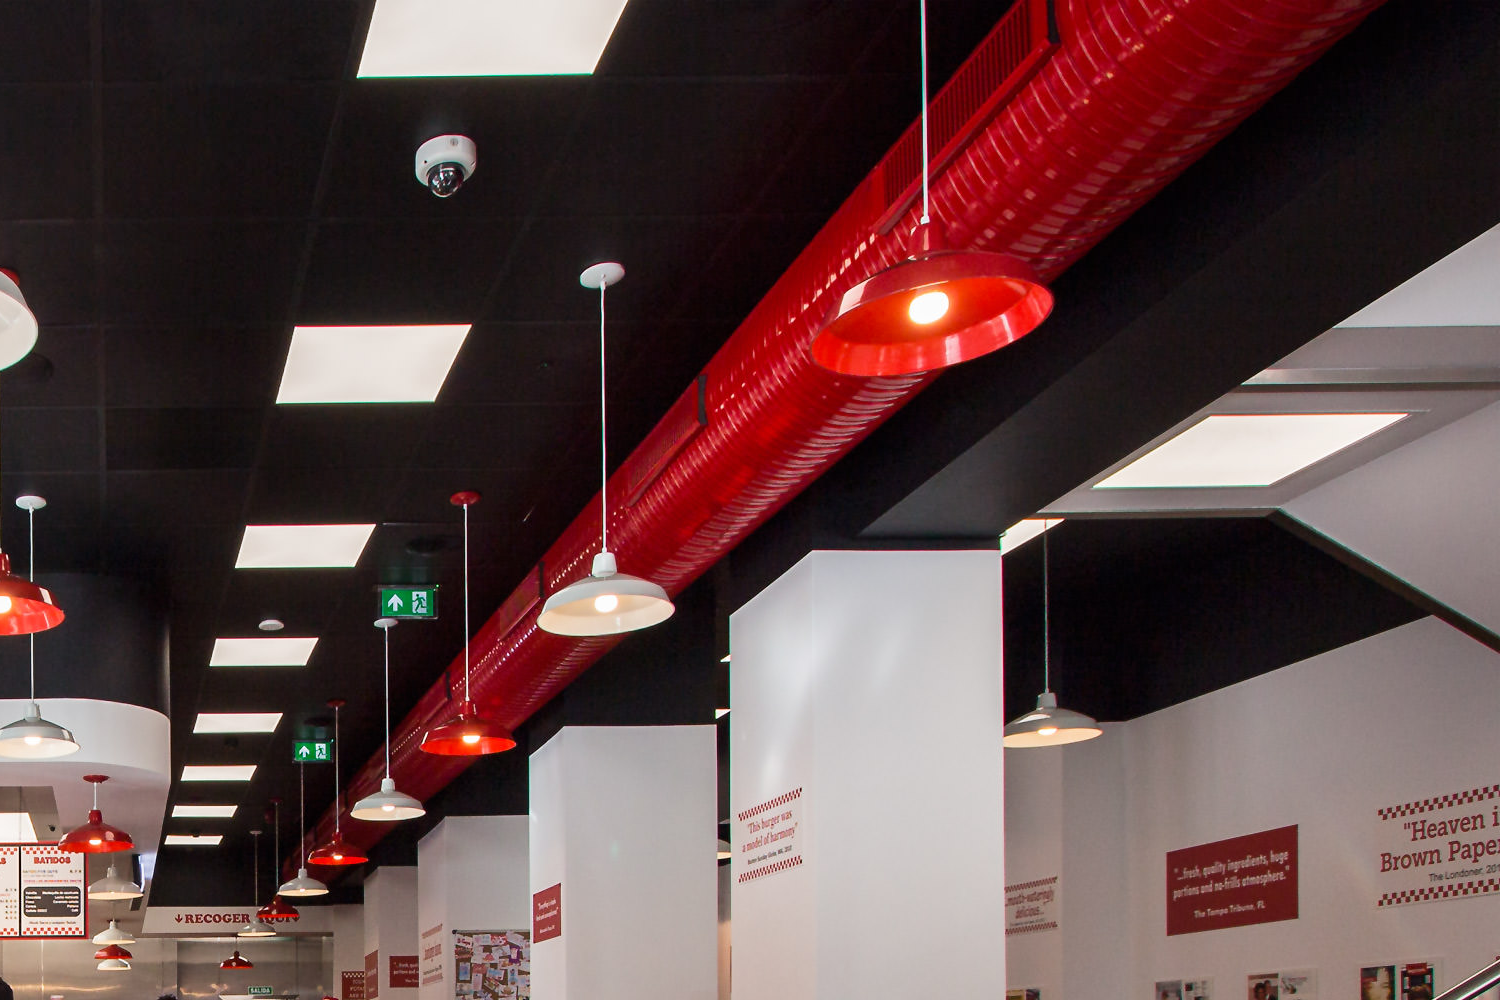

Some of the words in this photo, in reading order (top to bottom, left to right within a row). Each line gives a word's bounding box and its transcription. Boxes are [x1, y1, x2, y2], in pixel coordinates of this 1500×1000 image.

[761, 815, 779, 829] burger
[781, 811, 792, 821] was
[1403, 812, 1486, 841] "Heaven
[1492, 805, 1500, 827] i
[746, 835, 763, 851] model
[763, 832, 770, 845] of
[33, 856, 71, 864] BATIDOS
[1202, 861, 1226, 878] quality
[1270, 850, 1289, 864] huge
[1380, 848, 1442, 872] Brown
[1429, 873, 1443, 881] The
[1173, 884, 1199, 901] portions
[1200, 880, 1213, 893] and
[184, 913, 251, 923] RECOGER
[1193, 910, 1205, 919] The
[1206, 907, 1228, 917] Tampa
[1257, 900, 1266, 909] FL
